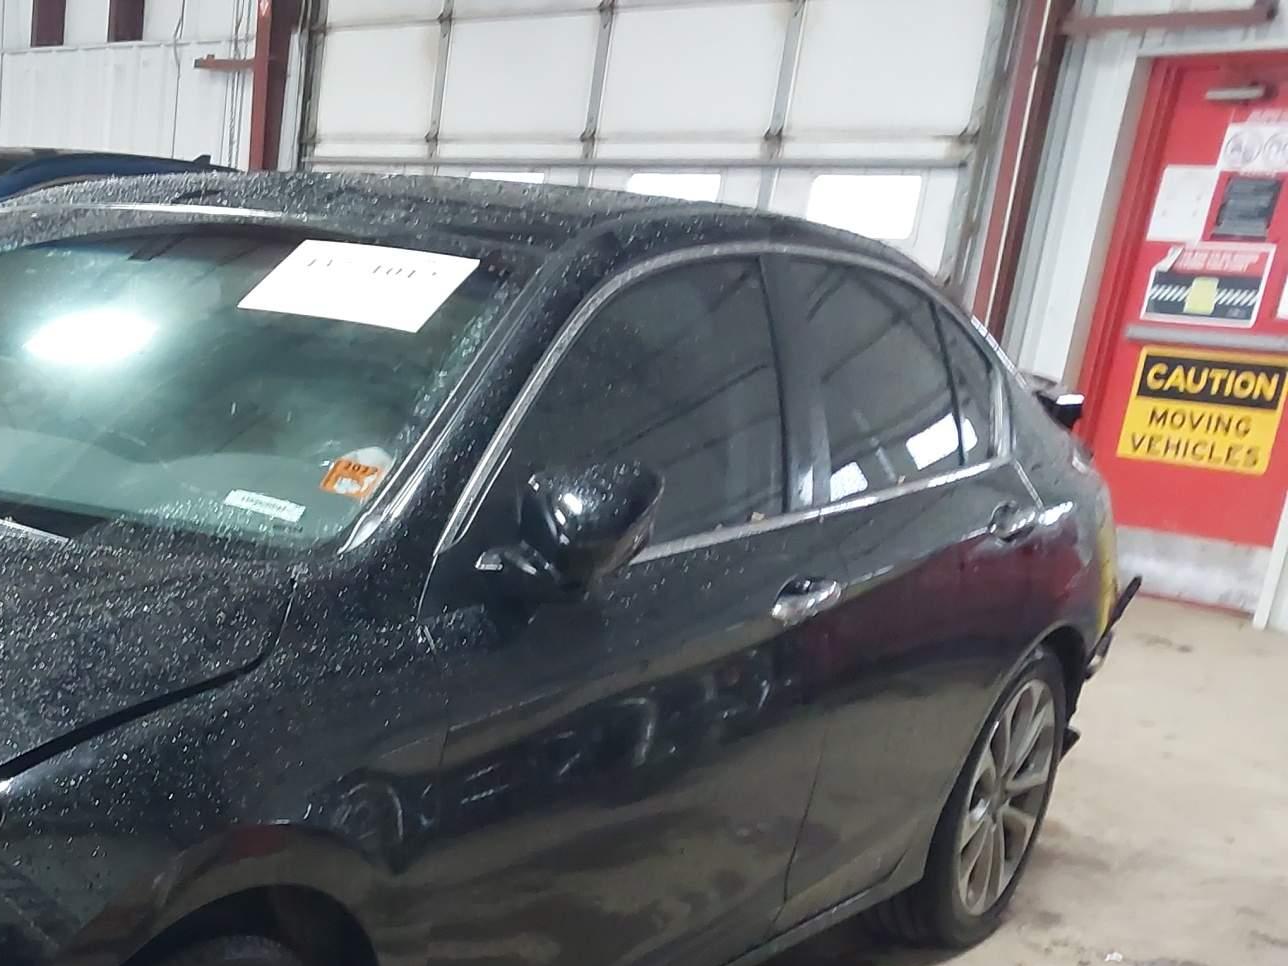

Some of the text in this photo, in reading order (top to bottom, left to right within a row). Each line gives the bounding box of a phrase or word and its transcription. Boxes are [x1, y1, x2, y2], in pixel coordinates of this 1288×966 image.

[1146, 362, 1280, 400] CAUTION
[1148, 406, 1252, 438] MOVING
[1131, 432, 1260, 467] VEHICLES
